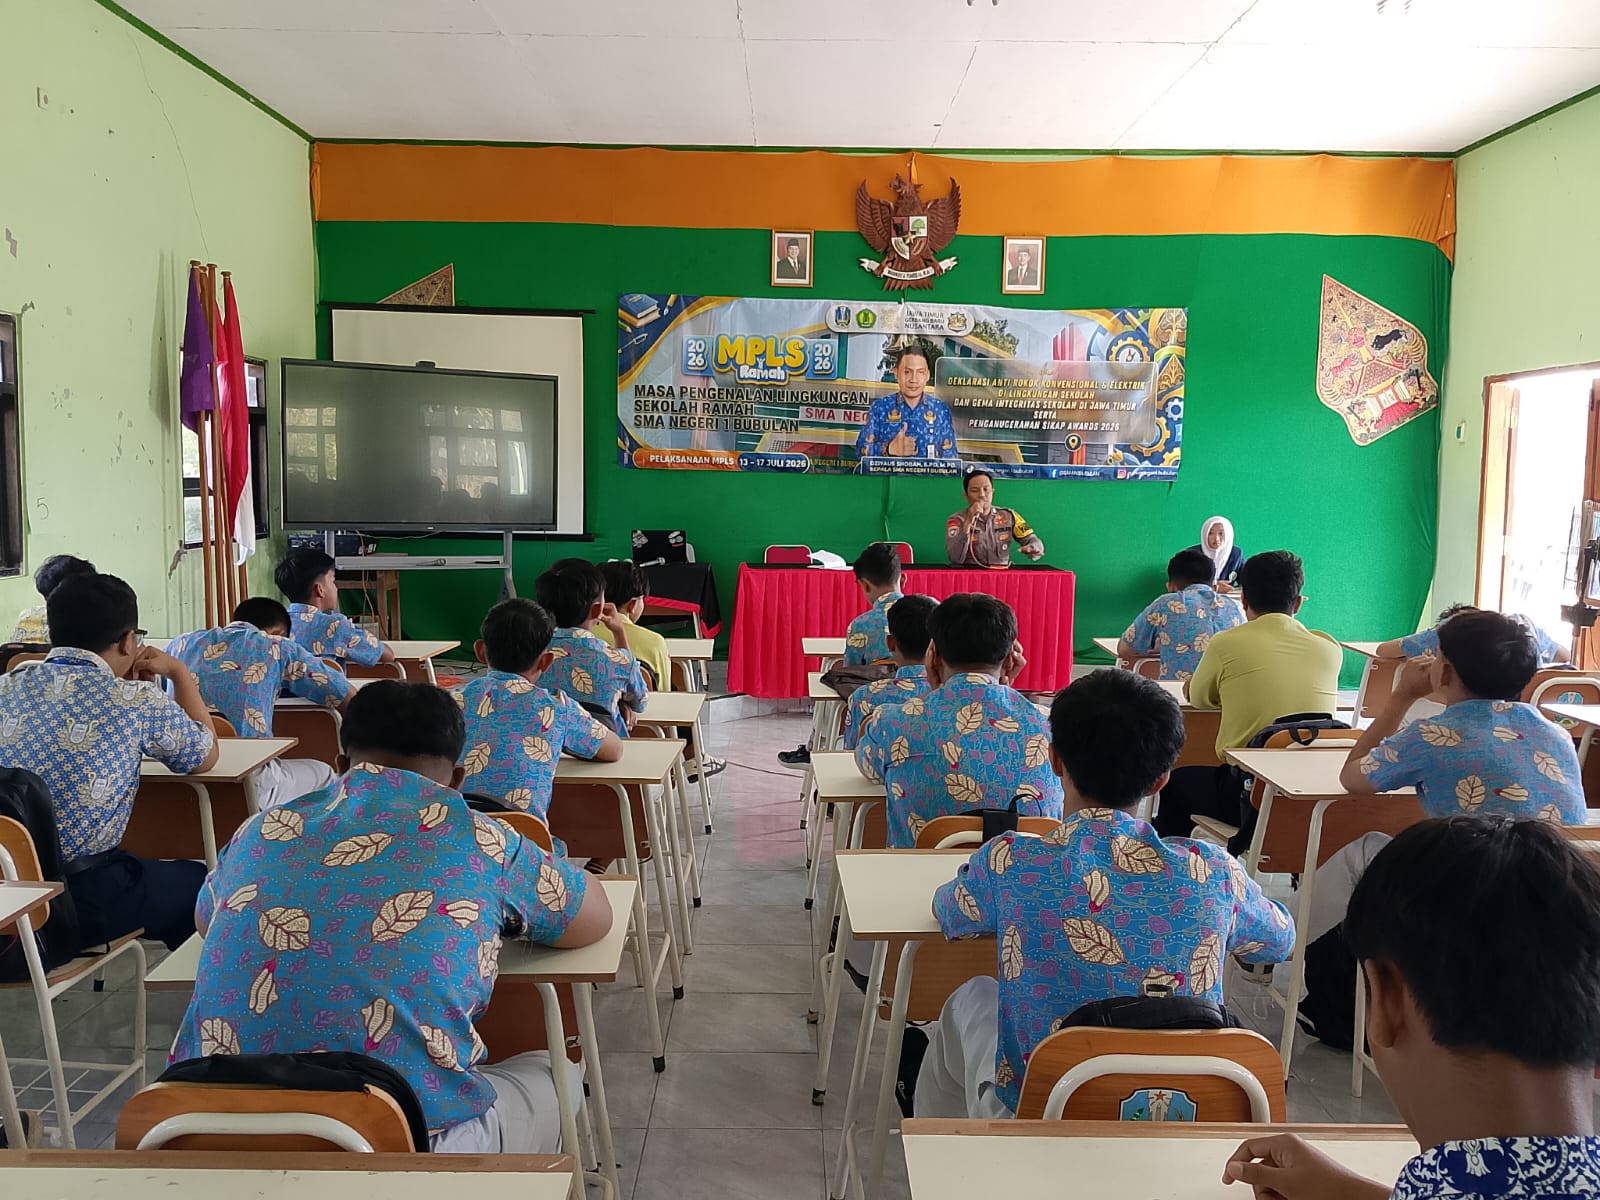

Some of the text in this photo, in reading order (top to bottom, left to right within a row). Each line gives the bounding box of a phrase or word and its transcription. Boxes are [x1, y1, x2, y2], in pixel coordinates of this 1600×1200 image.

[688, 340, 705, 352] 20
[717, 336, 805, 368] MPLS
[814, 344, 832, 356] 20
[688, 353, 705, 366] 26
[814, 357, 832, 370] 26
[740, 365, 785, 380] Ramah
[947, 376, 990, 386] DEKLARASI
[992, 378, 1010, 386] ANTI
[1013, 378, 1038, 388] ROKOK
[1042, 380, 1098, 389] KONVENSIONAL
[1110, 381, 1146, 390] ELEKTRIK
[634, 384, 870, 404] MASA PENGENALAN LINGKUNGAN
[998, 389, 1095, 400] DI LINGKUNGAN SEKOLAH
[634, 400, 754, 416] SEKOLAH RAMAH
[954, 398, 1136, 411] DAN GEMA INTEGRITAS SEKOLAH DI JAWA TIMUR
[805, 408, 868, 422] SMA NEG
[1034, 410, 1056, 420] SERTA
[634, 414, 800, 432] SMA NEGERI 1 BUBULAN
[968, 420, 1120, 431] PENGANUGERAHAN SIKAP AWARDS 2026
[650, 454, 734, 466] PELAKSANAAN MPLS
[740, 458, 748, 466] 13
[766, 459, 784, 467] JULI
[786, 460, 806, 468] 2026
